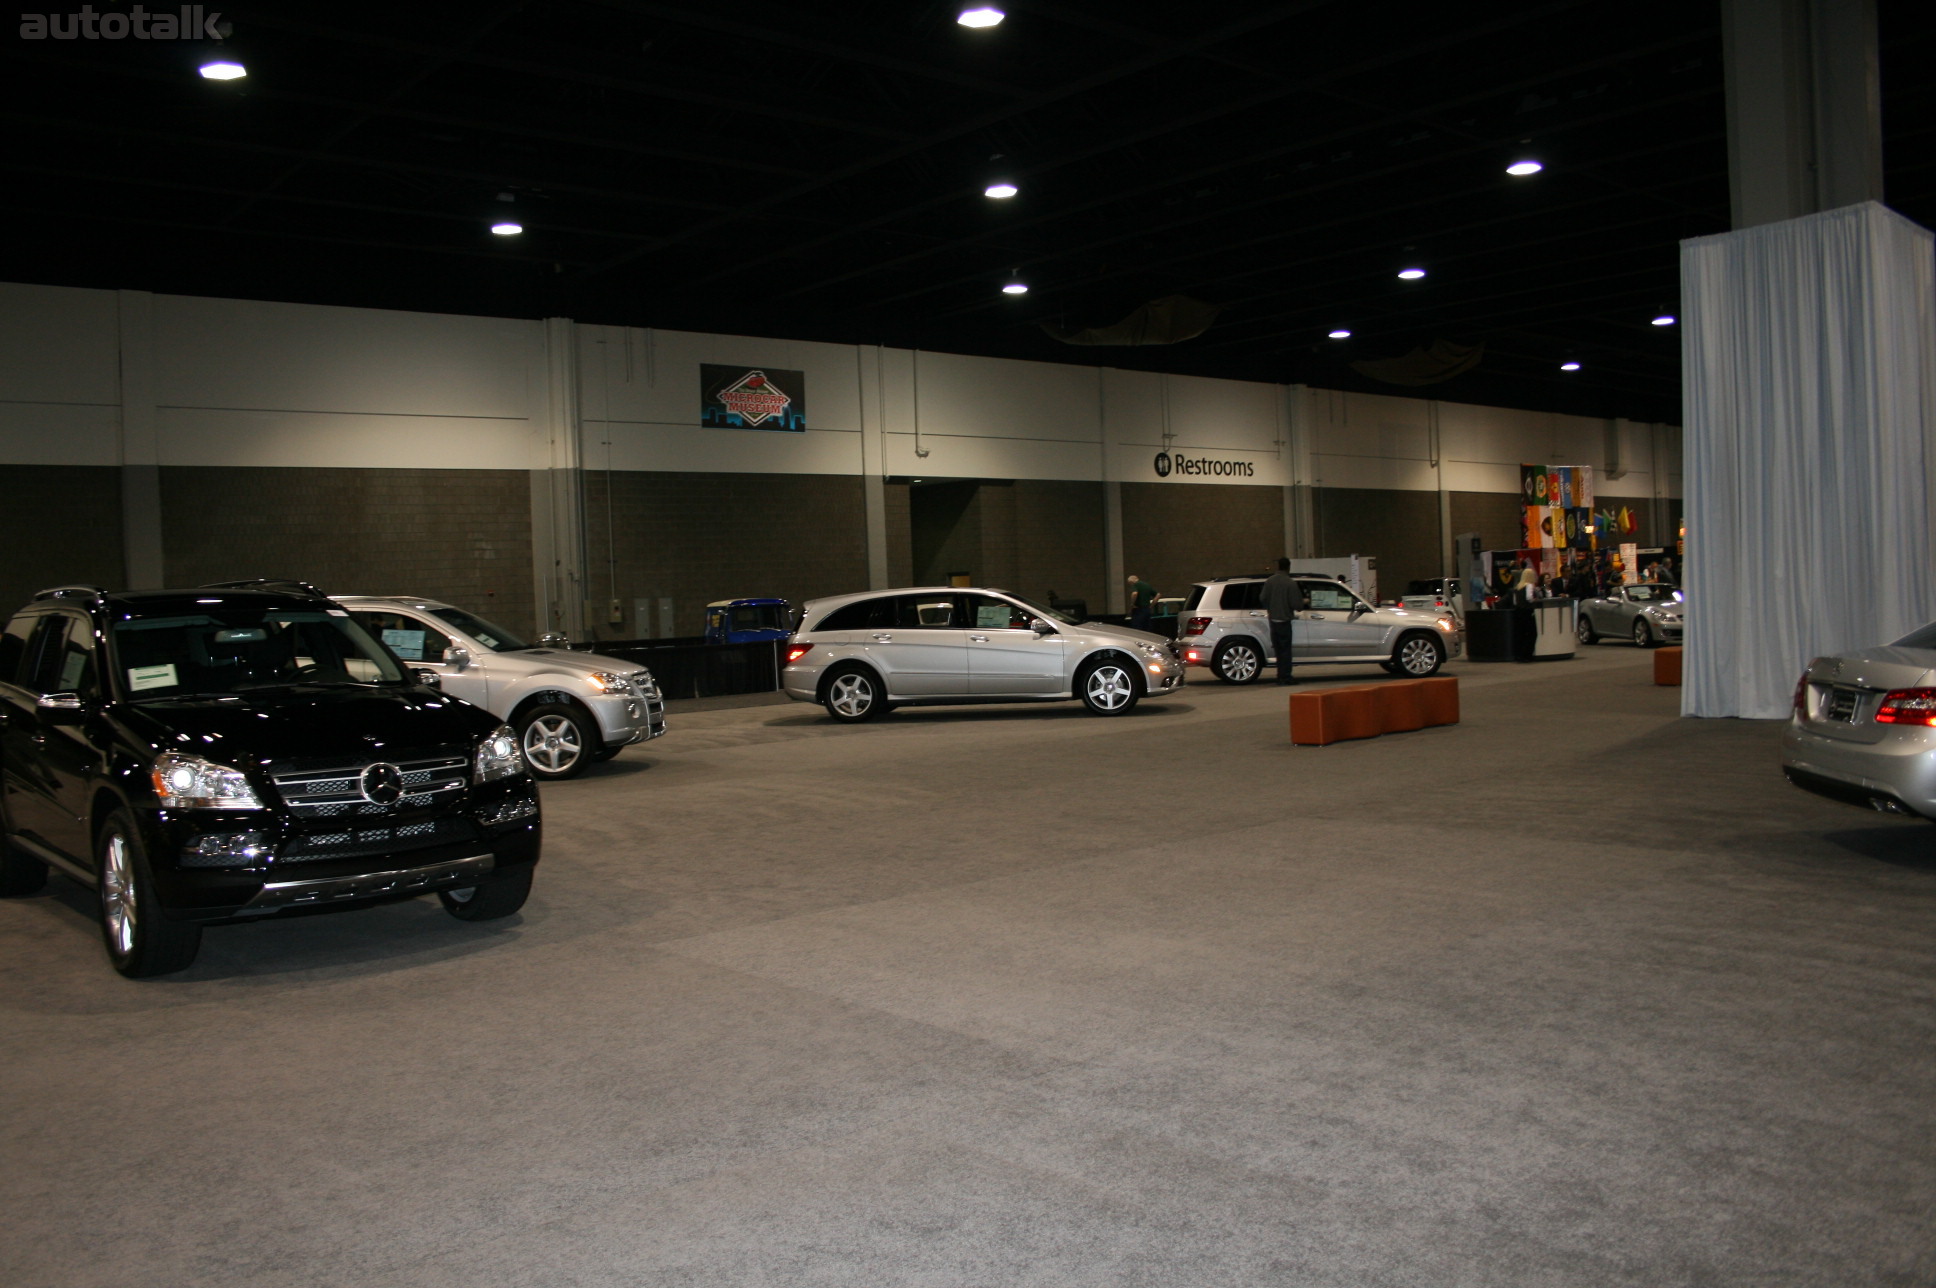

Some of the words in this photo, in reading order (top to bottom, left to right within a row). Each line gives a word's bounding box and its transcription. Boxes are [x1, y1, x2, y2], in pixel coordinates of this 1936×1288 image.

[723, 393, 785, 404] MICROCAR
[729, 403, 781, 413] MUSEUM
[1175, 454, 1254, 477] Restrooms
